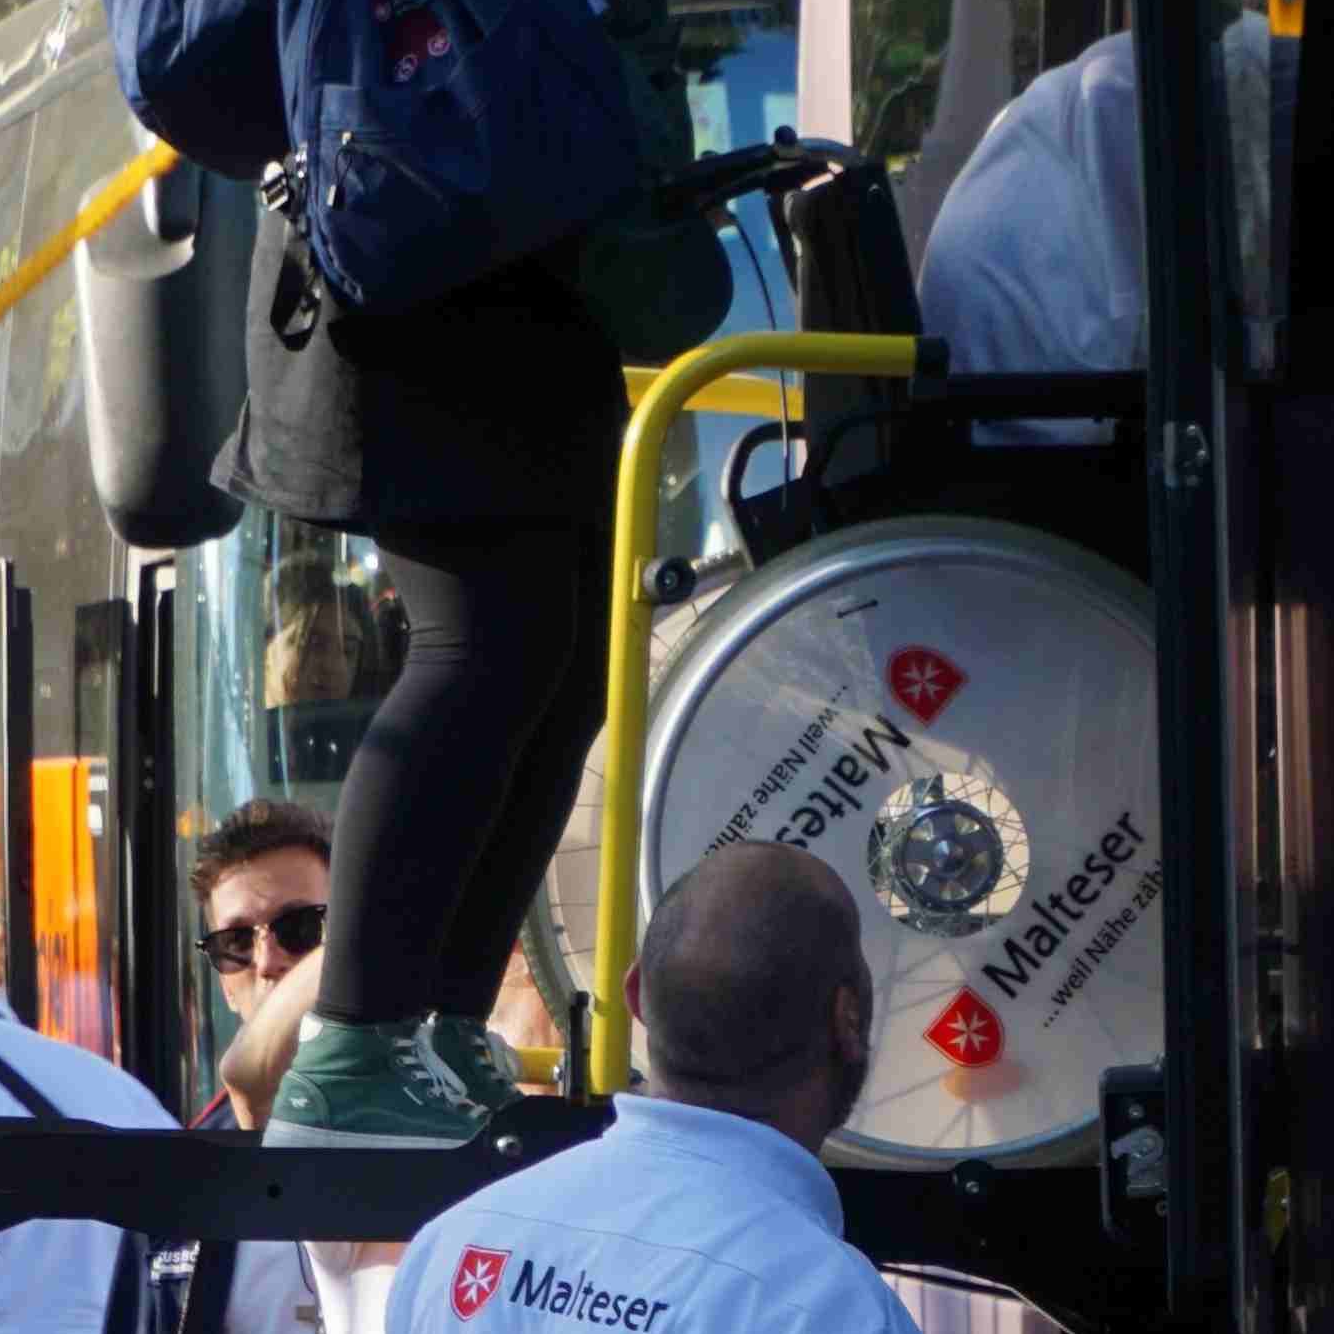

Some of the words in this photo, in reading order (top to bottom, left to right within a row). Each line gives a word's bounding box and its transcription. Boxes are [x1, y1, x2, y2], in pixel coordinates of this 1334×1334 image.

[753, 748, 807, 804] Nähe
[775, 713, 911, 849] Maltes
[981, 811, 1144, 999] Malteser
[1084, 907, 1137, 964] Nähe
[508, 1258, 670, 1333] Malteser
